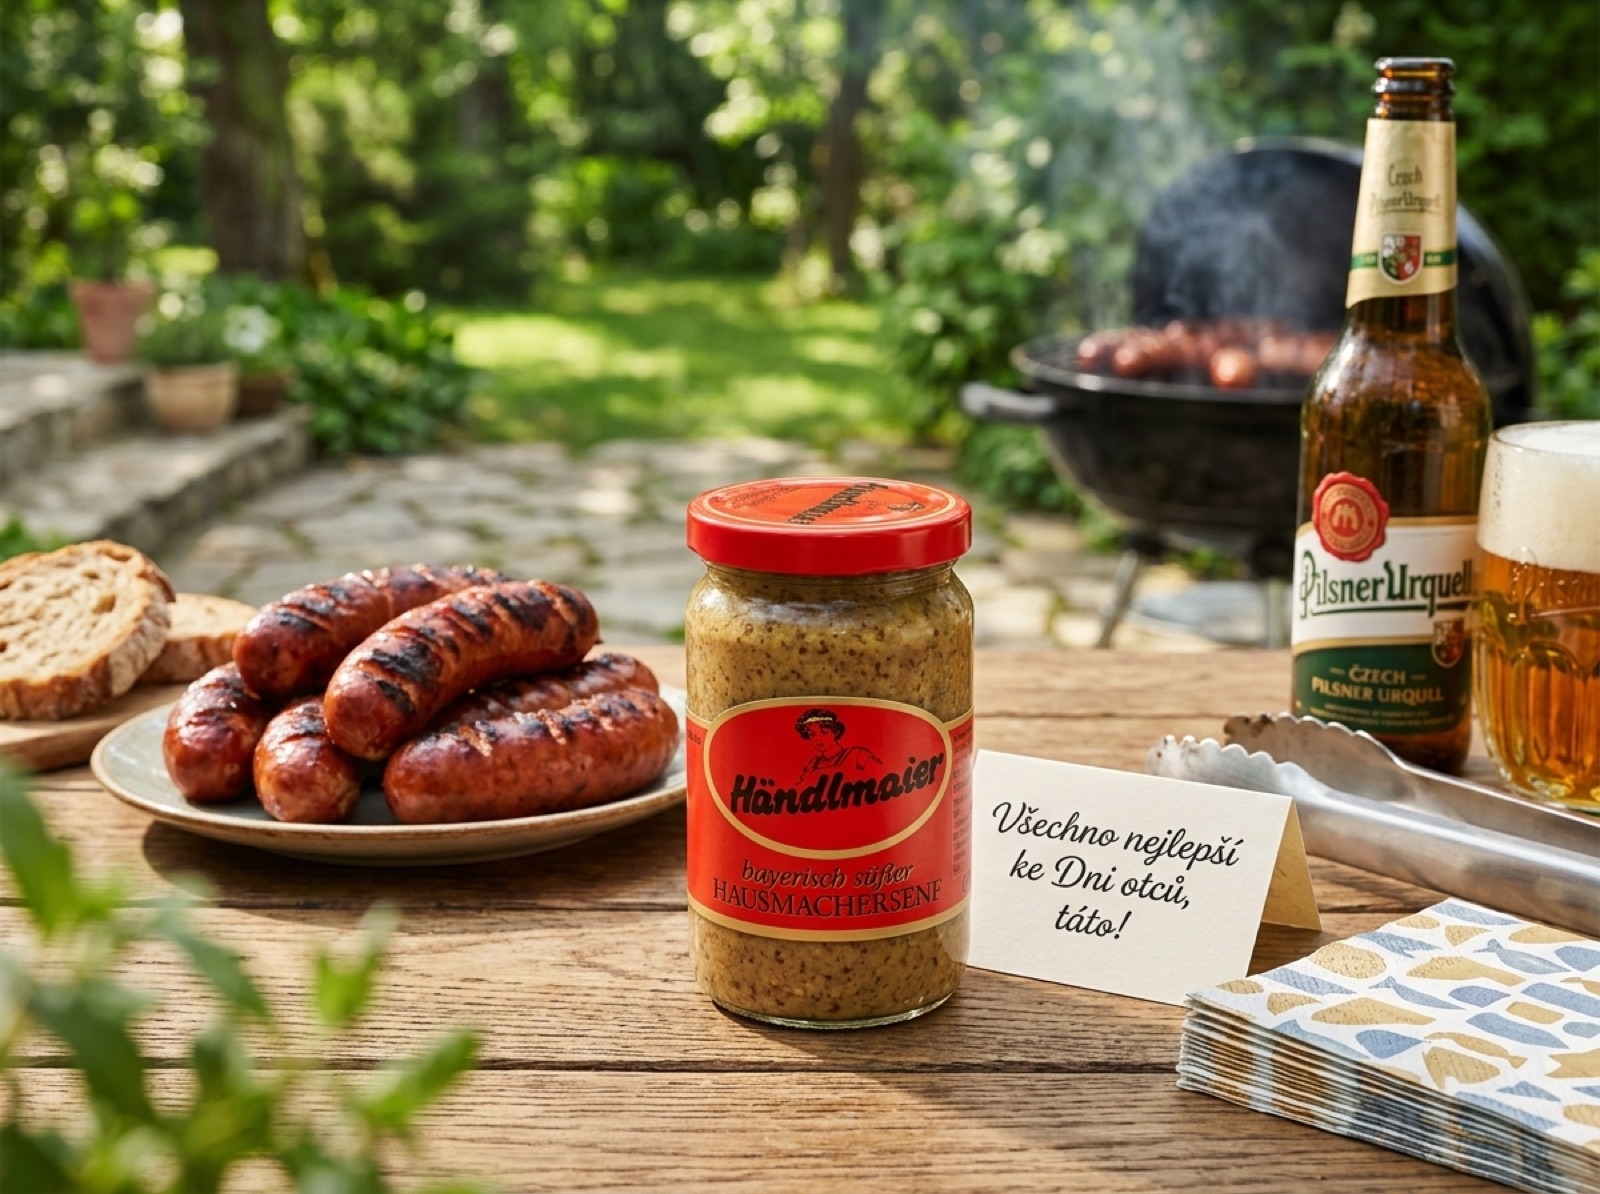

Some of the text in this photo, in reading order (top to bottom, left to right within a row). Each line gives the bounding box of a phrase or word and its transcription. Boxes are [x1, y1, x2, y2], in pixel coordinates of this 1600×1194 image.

[1311, 676, 1373, 701] PILSNER
[731, 752, 945, 815] Händlmaier
[992, 801, 1244, 871] Všechno nejlepší
[741, 859, 846, 889] bayerisch
[1009, 849, 1190, 910] ke Dni otců,
[1054, 904, 1132, 940] táto!
